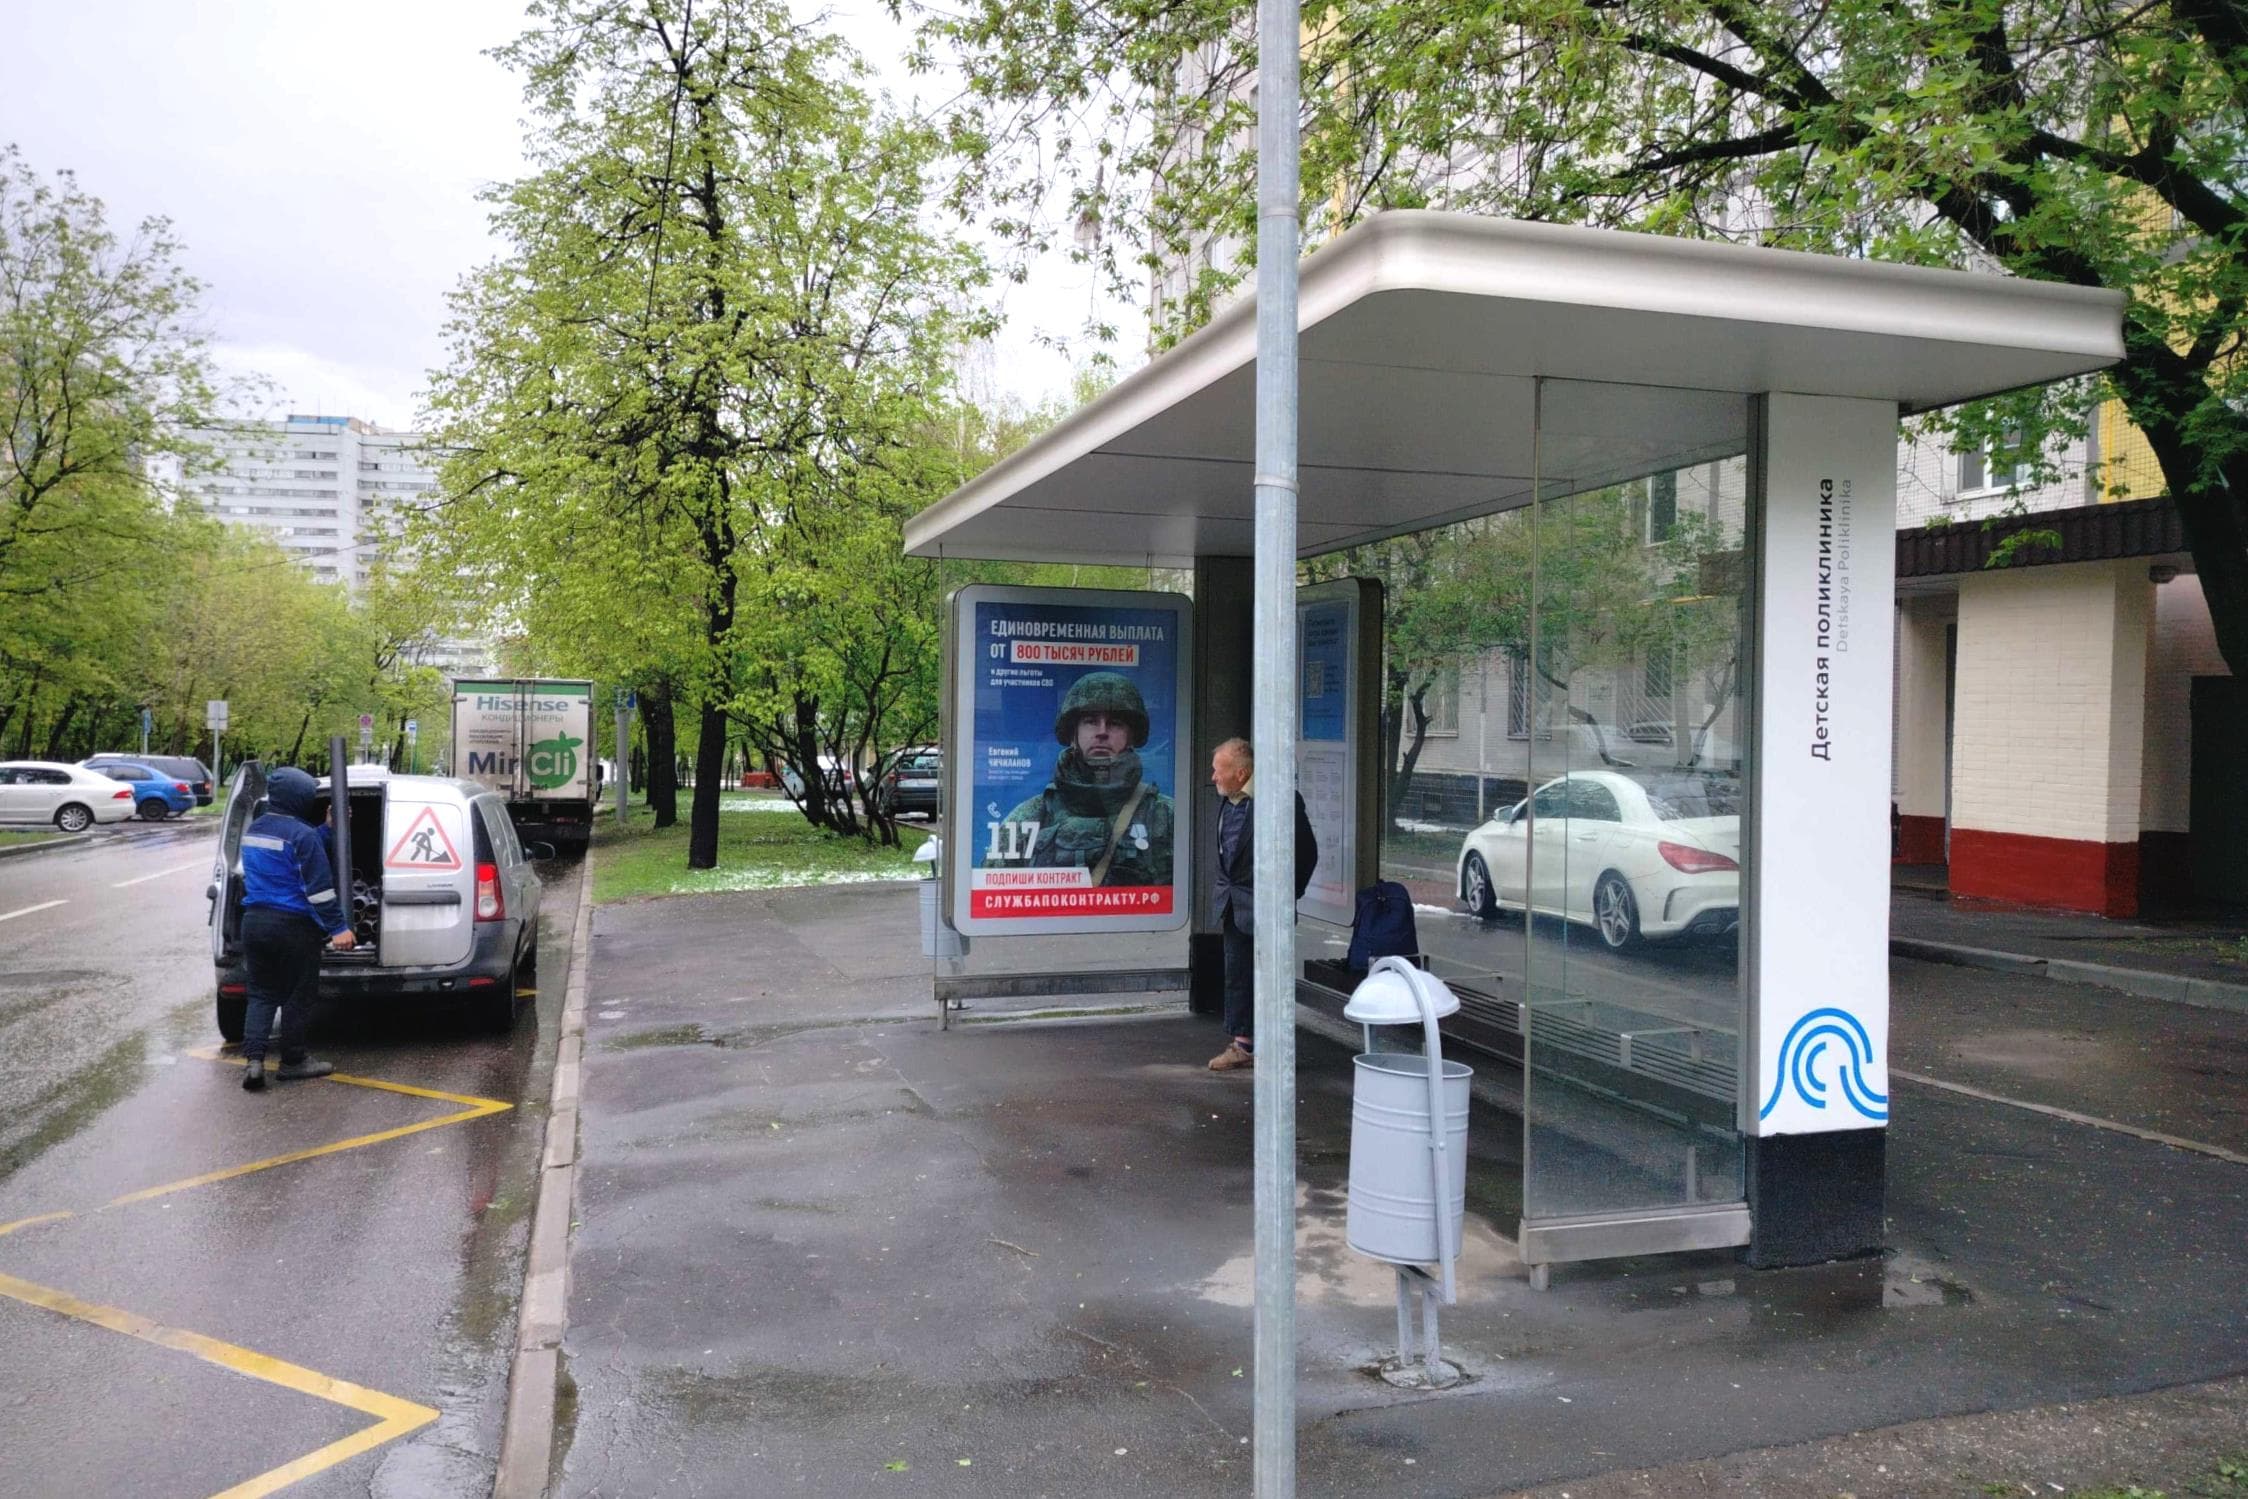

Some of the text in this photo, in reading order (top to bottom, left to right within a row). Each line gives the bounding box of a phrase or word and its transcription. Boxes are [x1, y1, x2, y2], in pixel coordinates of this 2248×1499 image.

[1836, 479, 1852, 653] Detskaya Poliklinika
[1811, 478, 1833, 761] Детская поликлиника
[991, 620, 1164, 641] ЕДИНОВРЕМЕННАЯ ВЫПЛАТА
[990, 643, 1134, 663] ОТ 800 ТЫСЯЧ РУБЛЕЙ
[476, 696, 569, 712] Hisense
[986, 821, 1040, 859] 117
[985, 871, 1082, 887] ПОДПИШИ КОНТРАКТ
[985, 893, 1161, 909] СЛУЖБАПОКОНТРАКТУ.РФ
